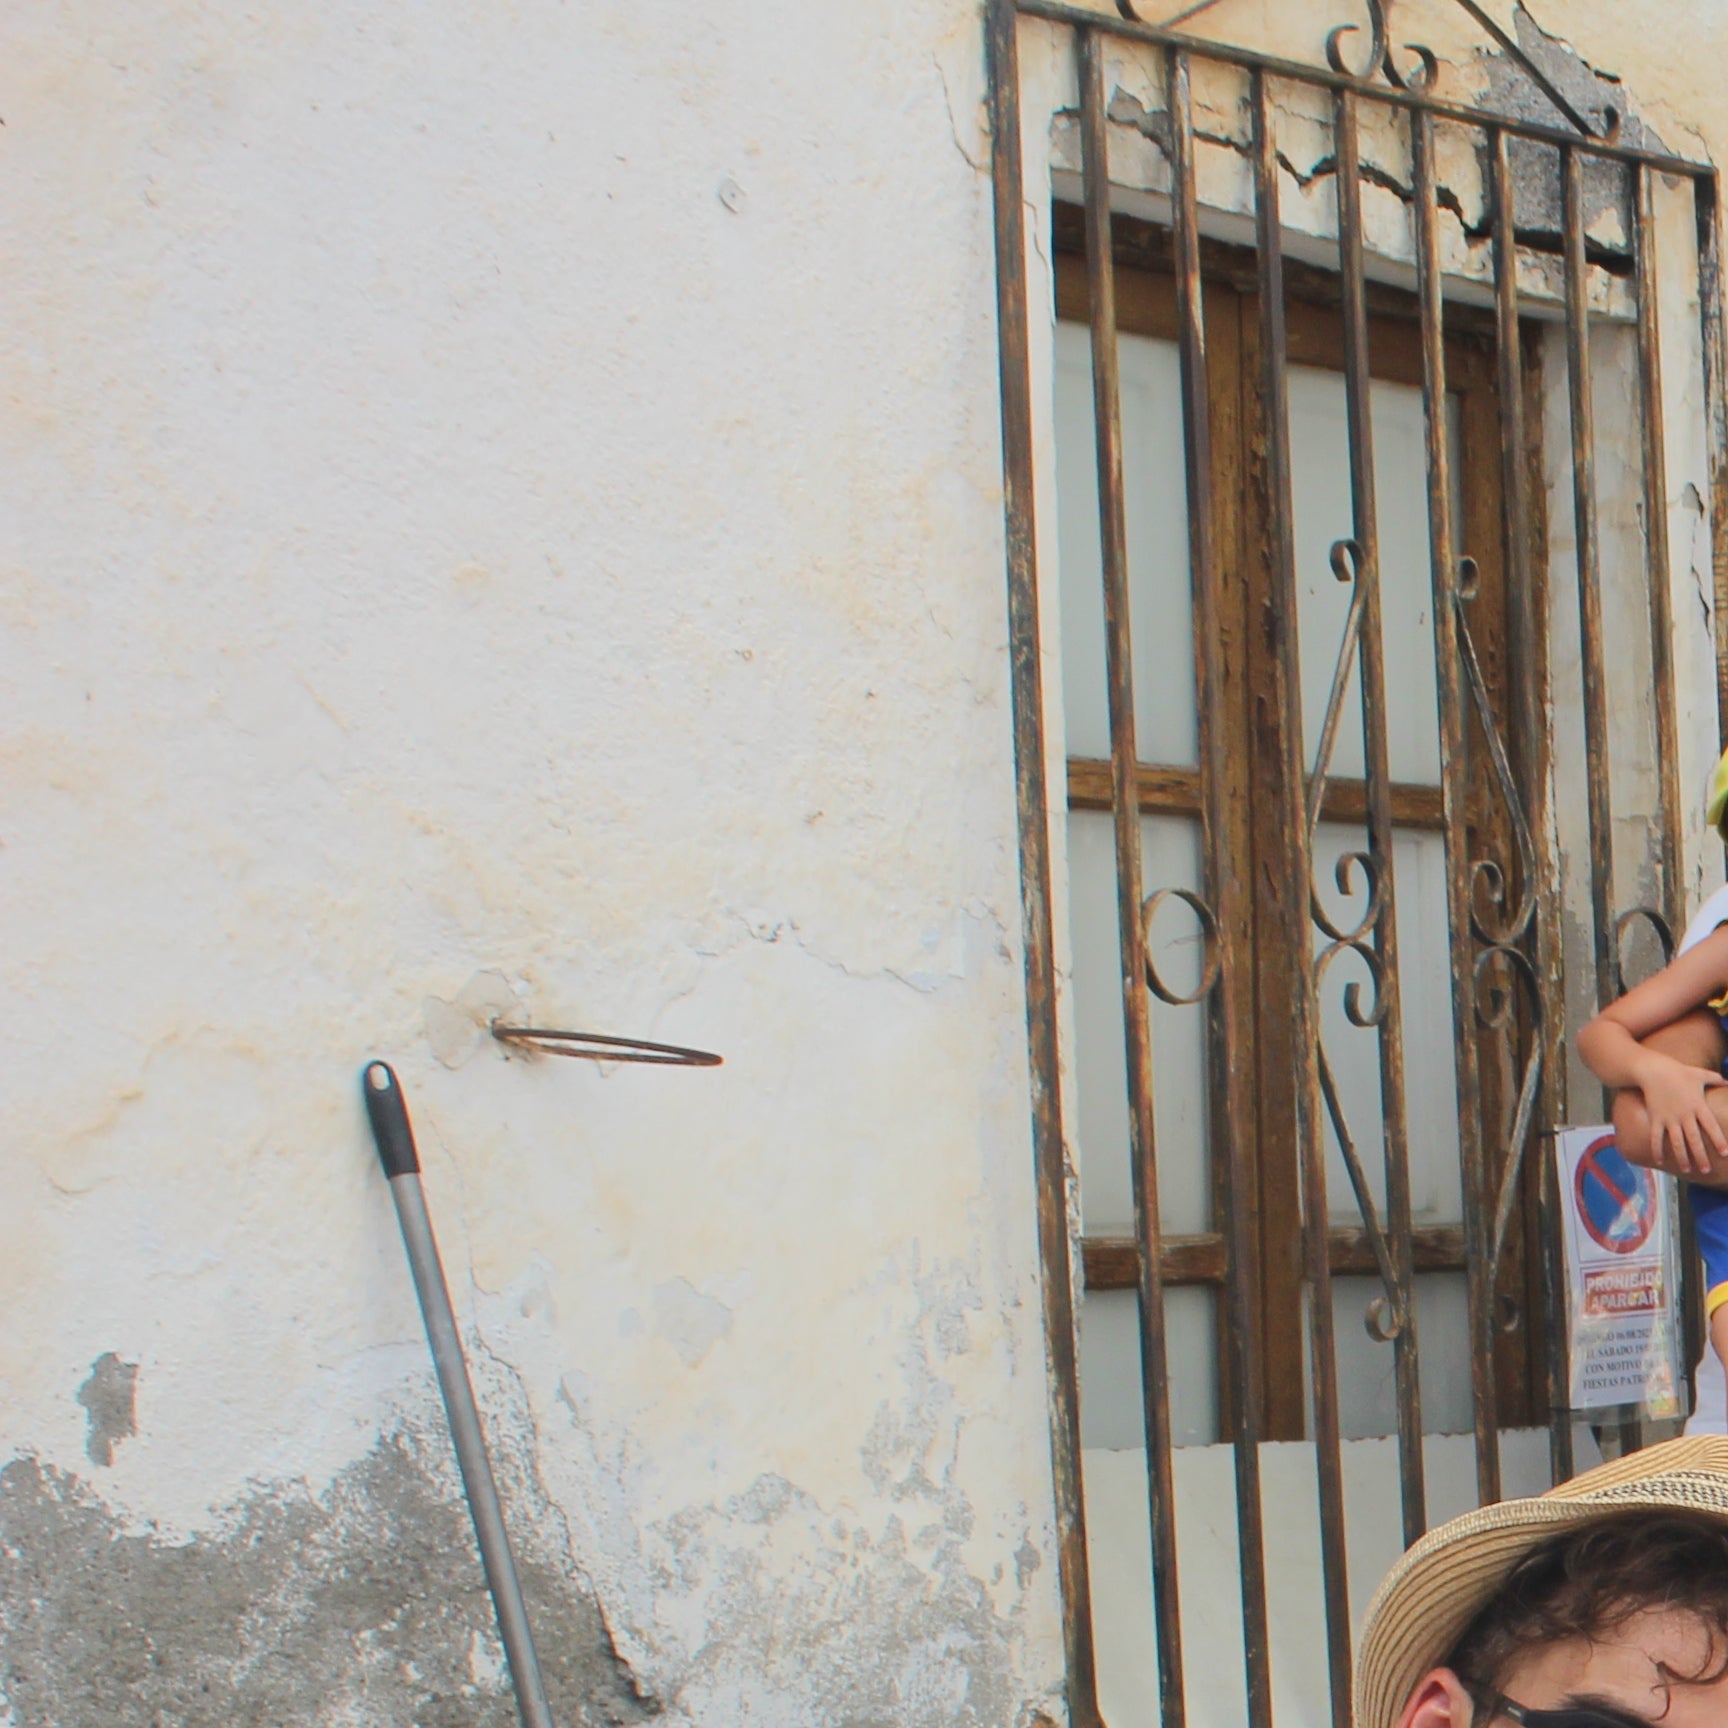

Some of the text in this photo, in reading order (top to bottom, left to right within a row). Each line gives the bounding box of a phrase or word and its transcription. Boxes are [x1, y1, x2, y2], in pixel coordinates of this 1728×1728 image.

[1586, 1271, 1663, 1292] PROHIBIDO
[1592, 1290, 1660, 1311] APARCAR
[1606, 1361, 1642, 1373] MOTIVO
